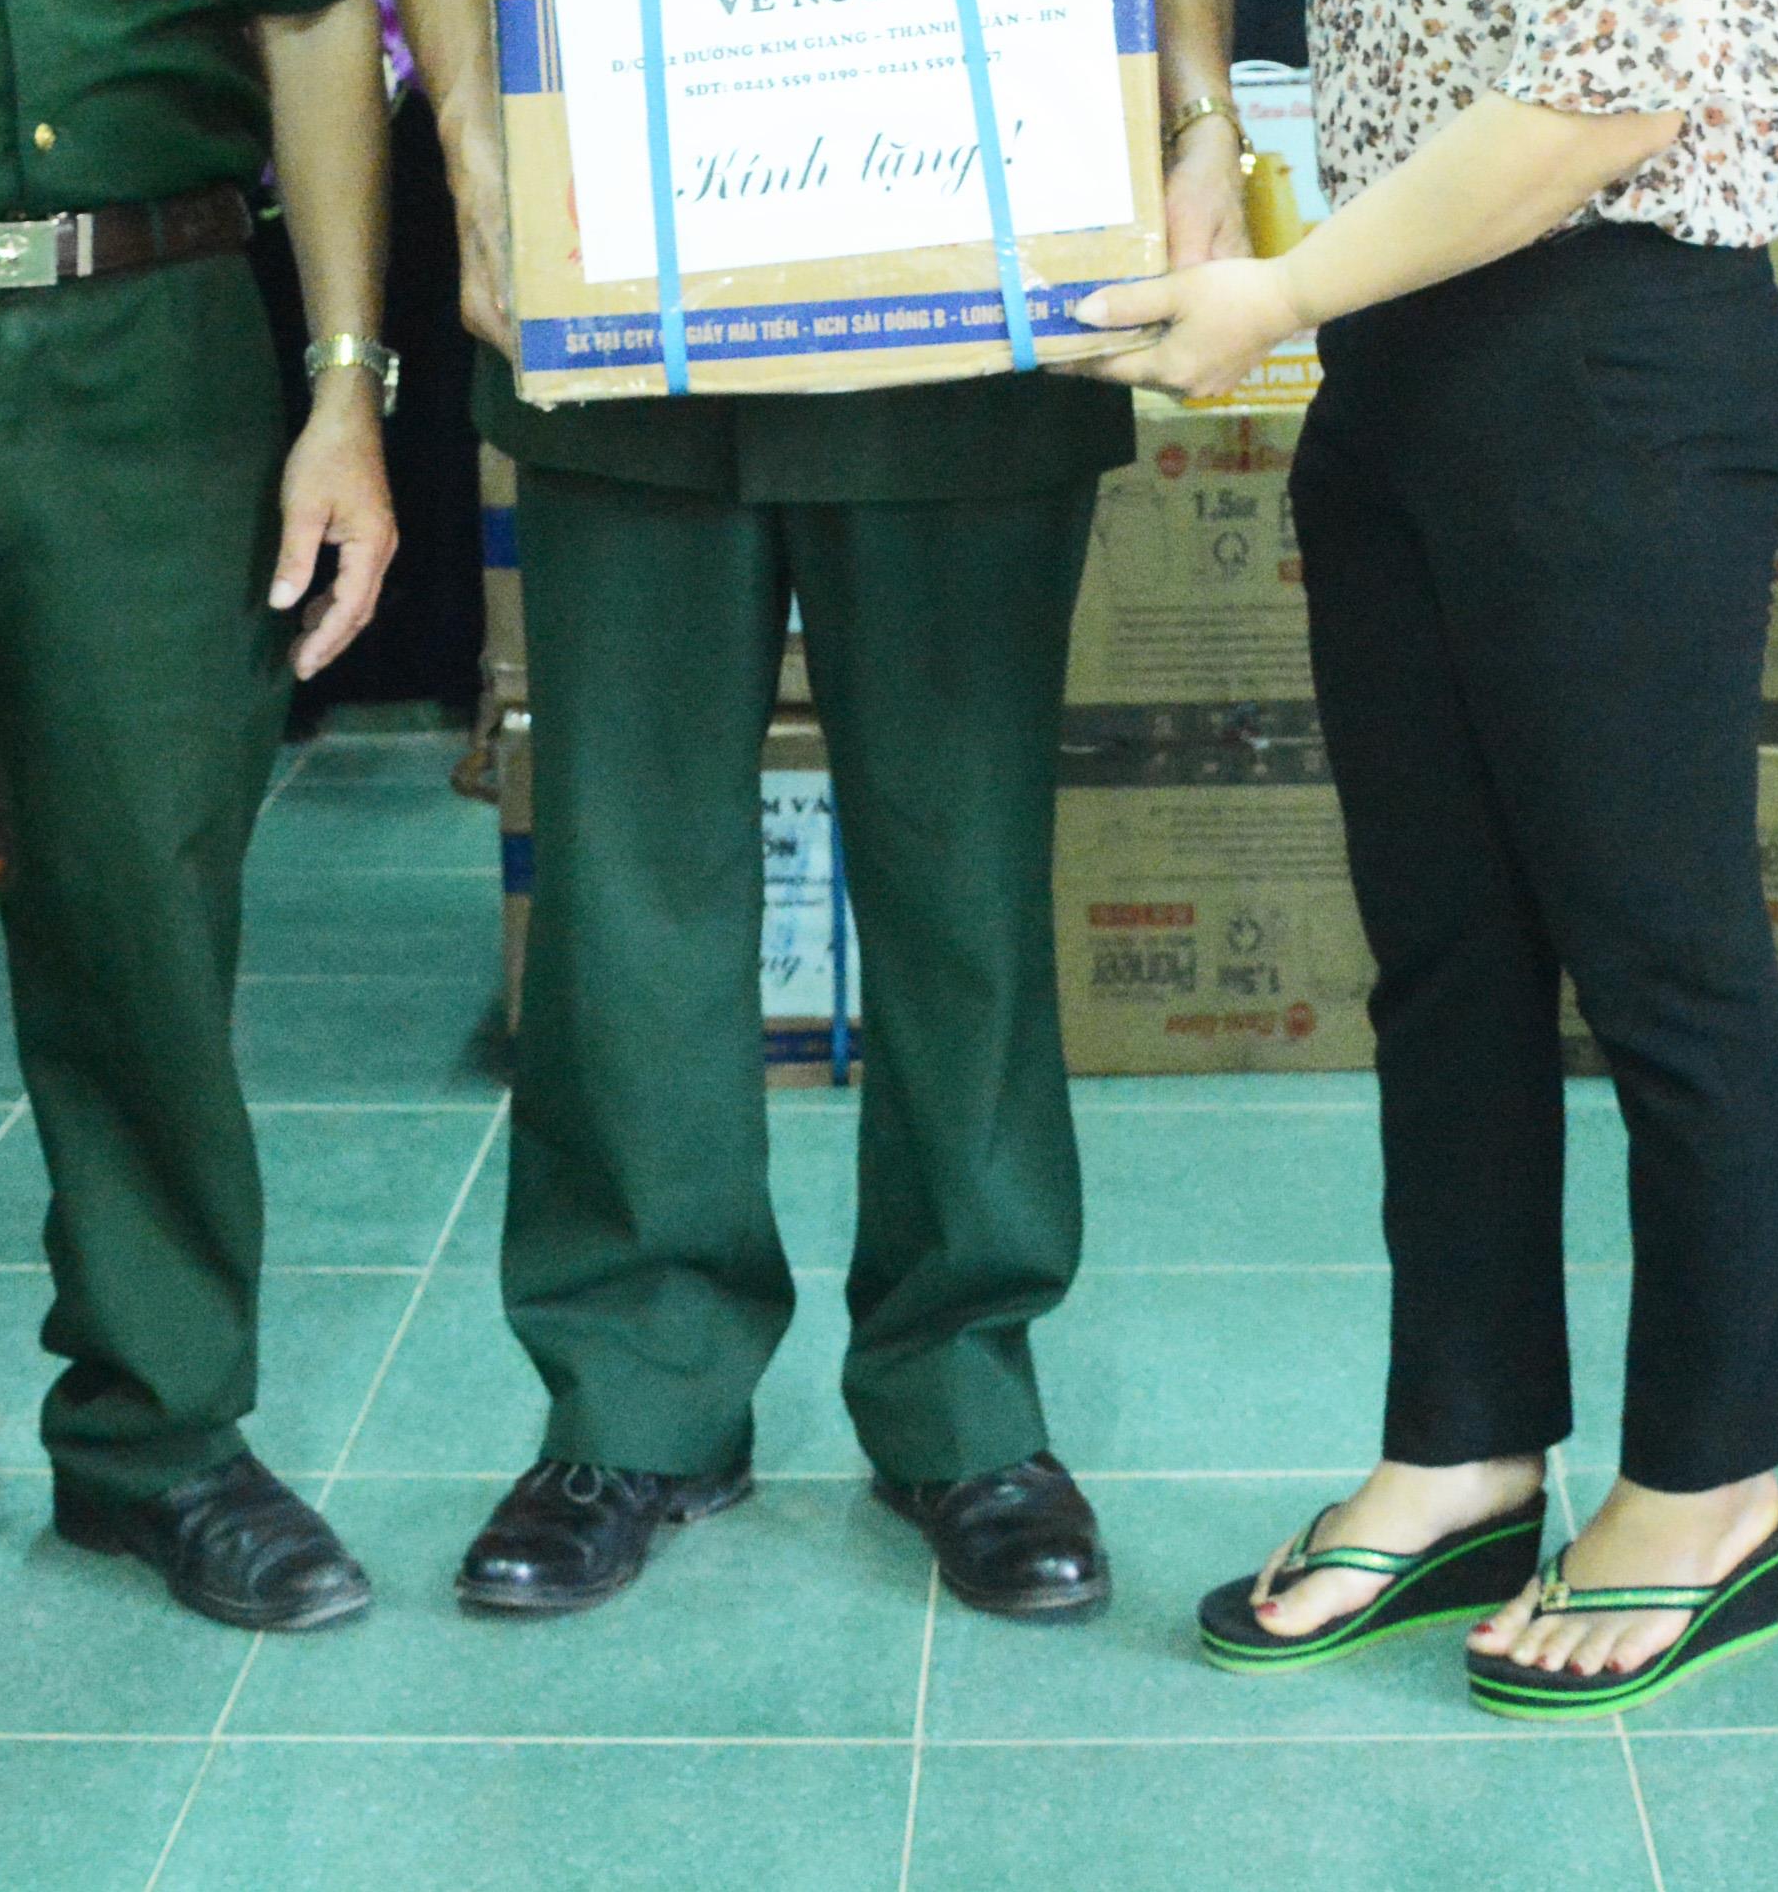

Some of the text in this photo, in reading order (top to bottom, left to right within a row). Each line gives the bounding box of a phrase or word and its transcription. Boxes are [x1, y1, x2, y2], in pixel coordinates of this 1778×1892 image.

[760, 38, 798, 55] KIM
[803, 29, 869, 50] GIANG
[887, 19, 957, 41] THANH
[675, 134, 829, 203] Kính
[624, 328, 655, 351] CTY
